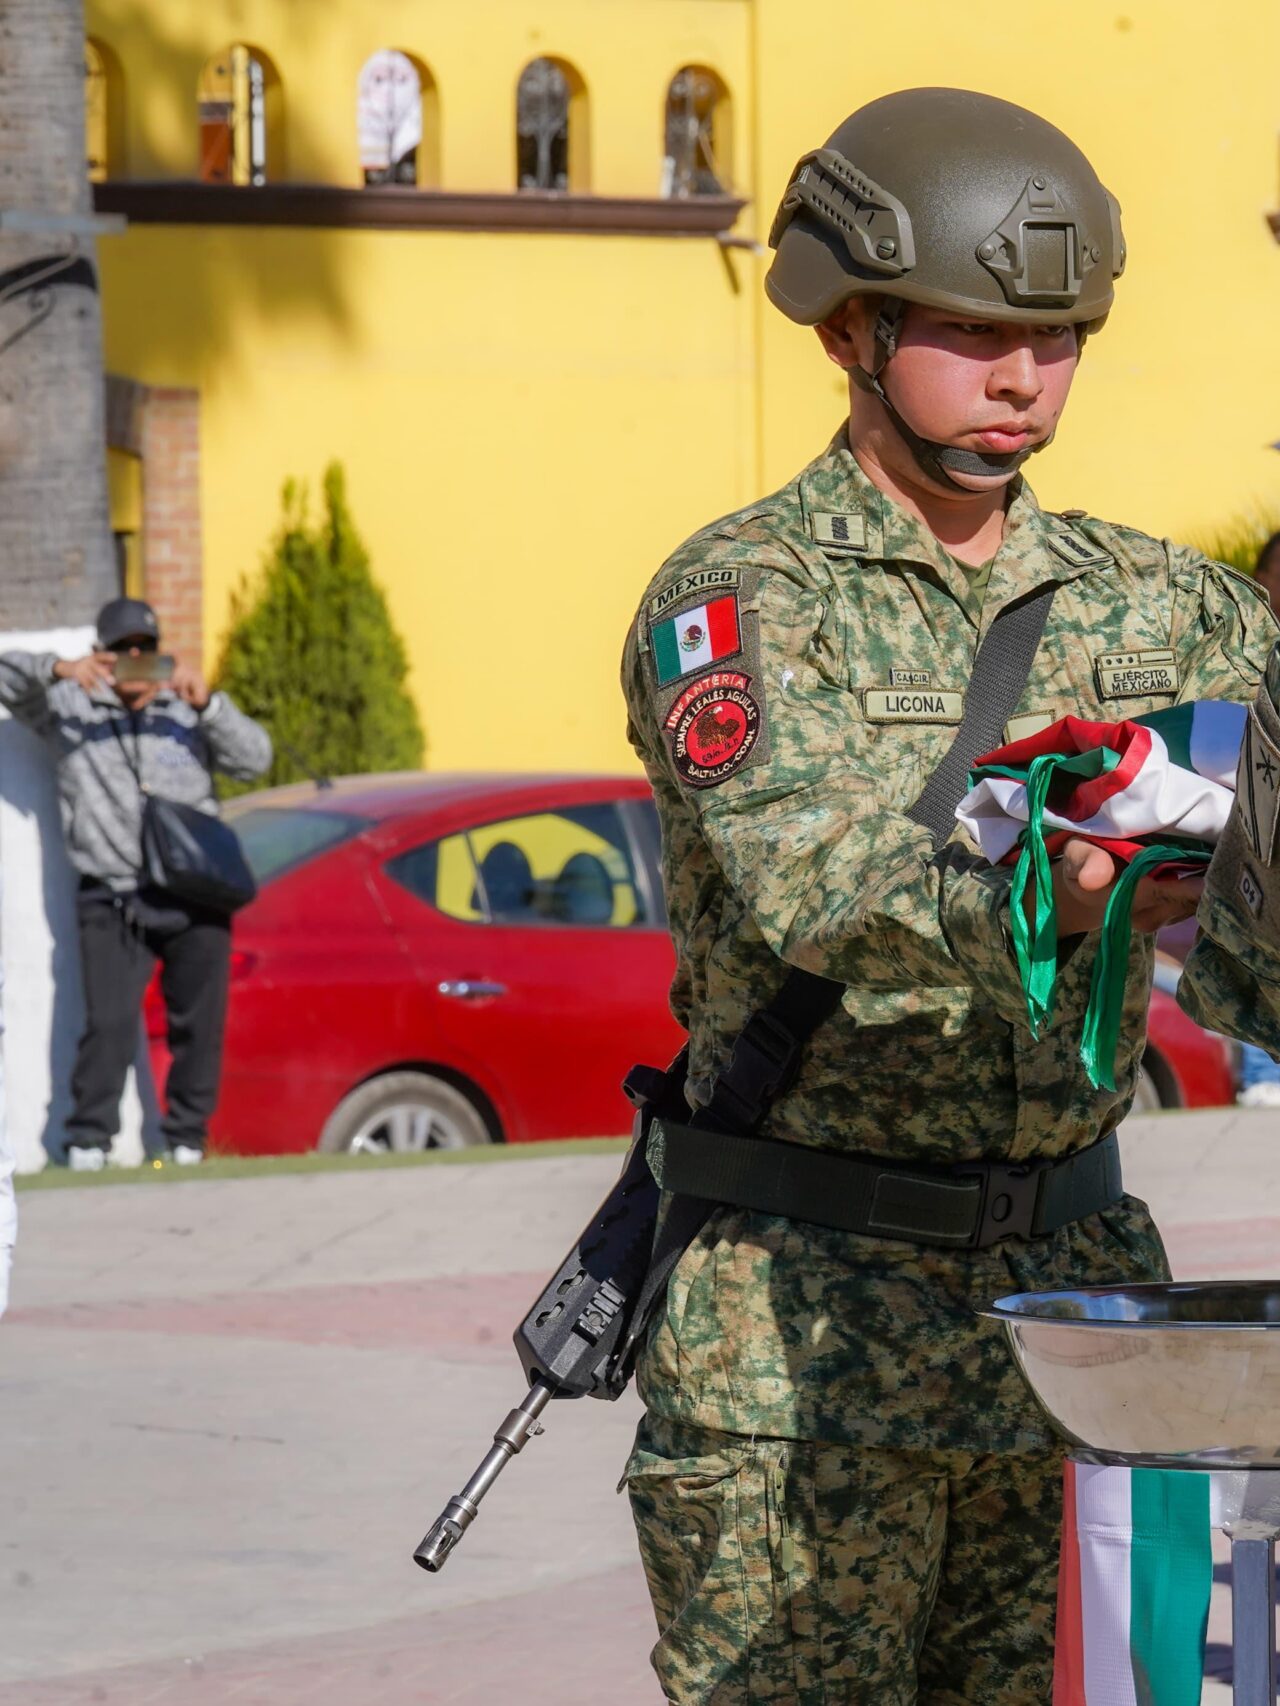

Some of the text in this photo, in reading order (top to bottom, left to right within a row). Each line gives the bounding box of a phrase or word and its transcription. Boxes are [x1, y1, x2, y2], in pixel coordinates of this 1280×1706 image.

[657, 571, 733, 608] MEXICO
[1113, 669, 1168, 682] EJÉRCITO
[1111, 678, 1172, 692] MEXICANO
[886, 695, 946, 713] LICONA
[677, 689, 757, 758] SIEMPRE LEALES AGUILAS
